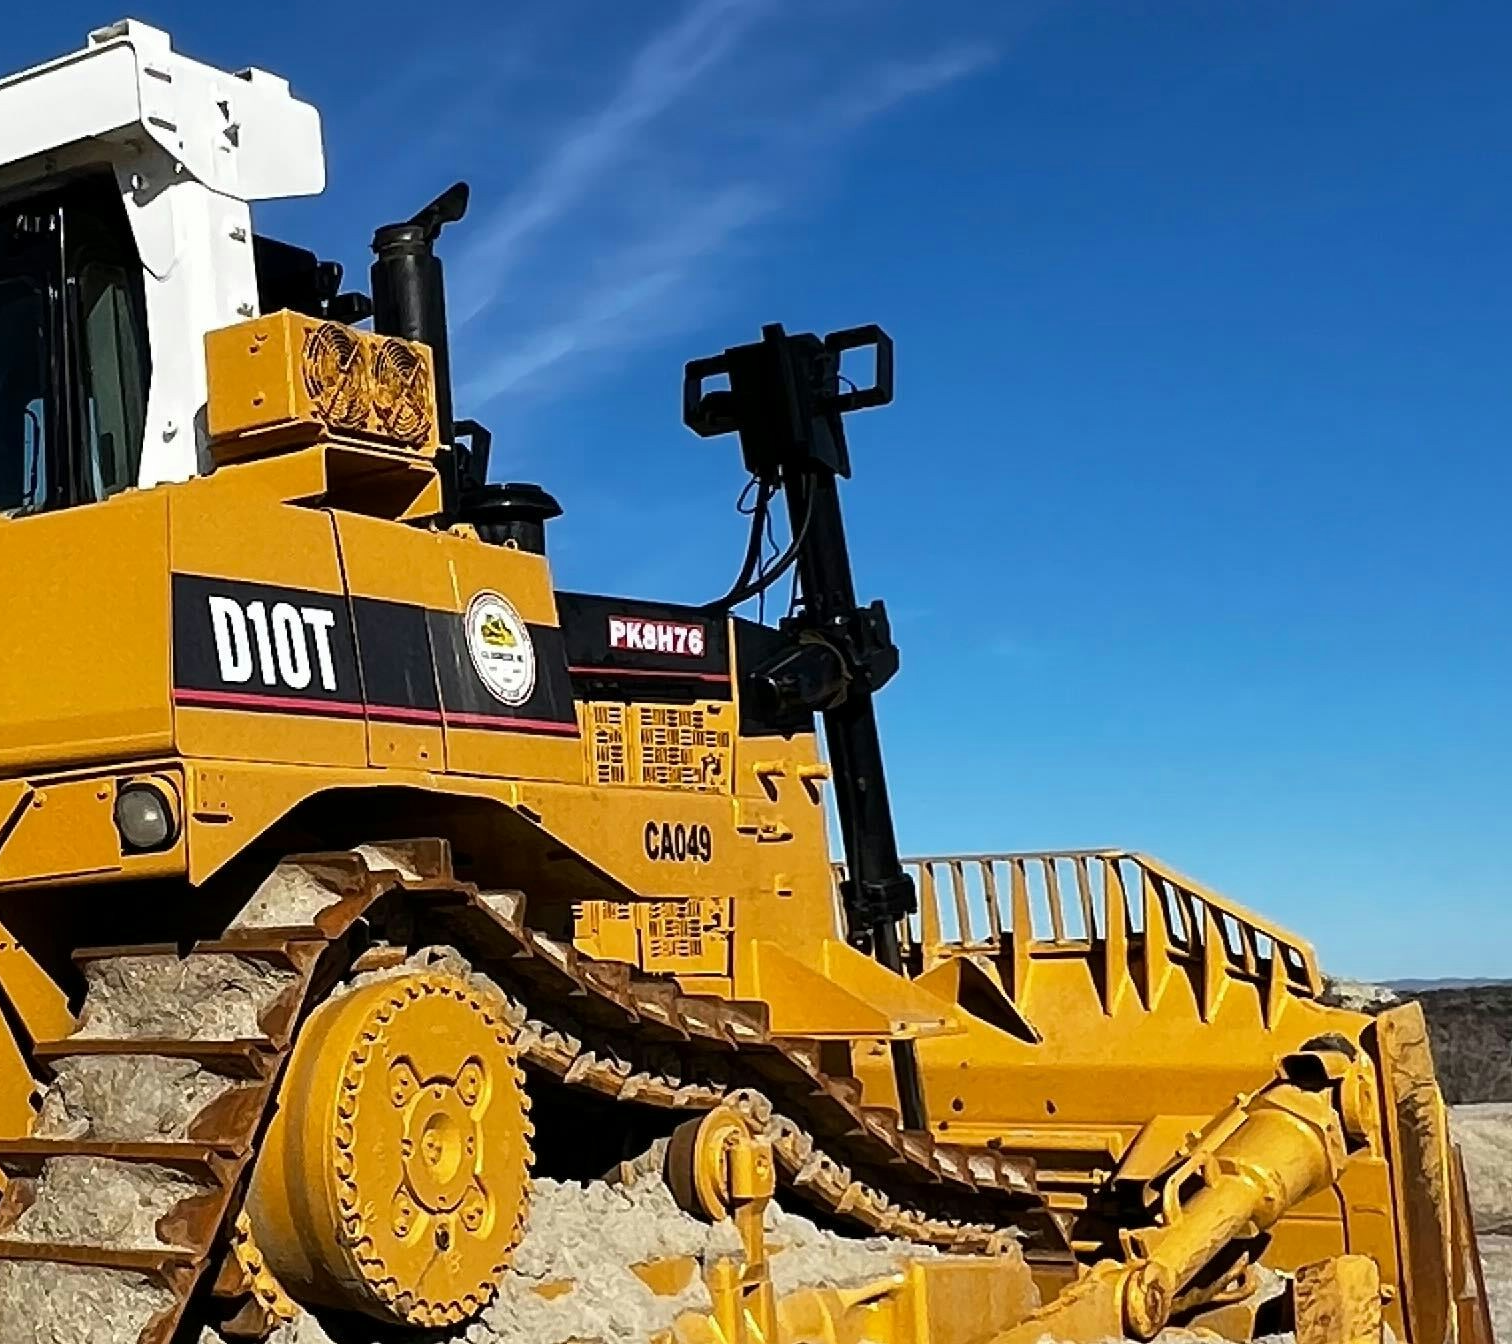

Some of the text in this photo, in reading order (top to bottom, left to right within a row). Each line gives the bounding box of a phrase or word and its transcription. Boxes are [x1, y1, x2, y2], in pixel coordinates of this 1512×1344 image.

[209, 595, 337, 691] D10T
[610, 620, 704, 655] PK8H76
[645, 821, 711, 862] CA049
